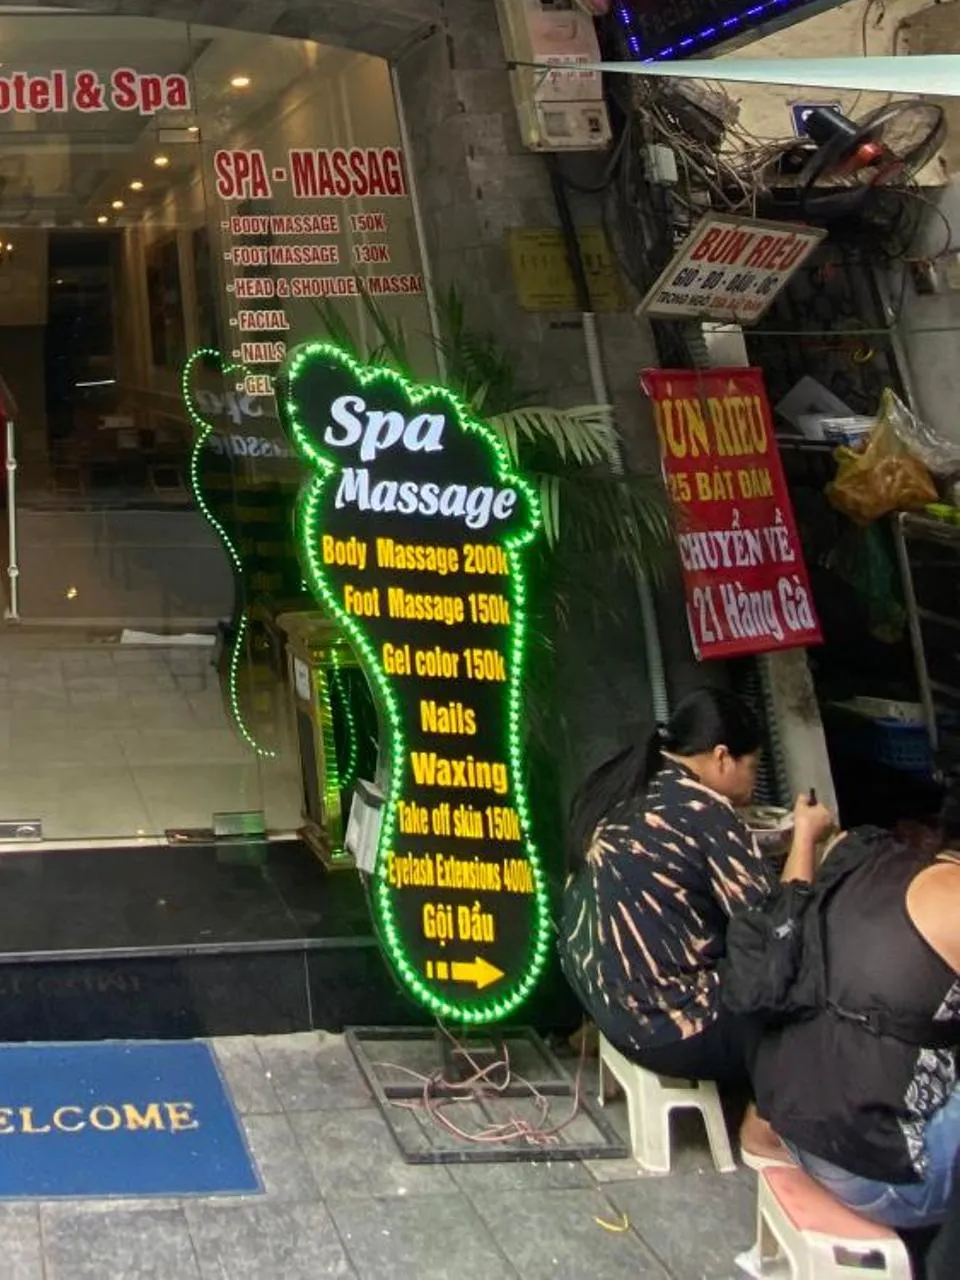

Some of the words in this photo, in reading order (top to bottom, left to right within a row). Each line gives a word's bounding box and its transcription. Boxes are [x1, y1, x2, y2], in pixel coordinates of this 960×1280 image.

[74, 70, 105, 113] &
[112, 68, 191, 114] Spa
[215, 149, 272, 199] SPA
[231, 215, 269, 234] BODY
[270, 215, 339, 234] MASSAGE
[351, 212, 387, 232] 150K
[233, 246, 269, 265] FOOT
[271, 245, 339, 265] MASSAGE
[355, 244, 390, 264] 130K
[234, 278, 274, 298] HEAD
[277, 277, 290, 297] &
[239, 310, 289, 331] FACIAL
[242, 341, 285, 363] NAILS
[244, 375, 274, 395] GEL
[324, 395, 446, 461] Spa
[335, 468, 517, 529] Massage
[322, 535, 367, 570] Body
[376, 537, 459, 575] Massage
[463, 544, 509, 576] 200k
[344, 584, 380, 617] Foot
[388, 588, 464, 625] Massage
[468, 593, 510, 625] 150k
[693, 586, 724, 643] 21
[720, 581, 784, 641] Hàng
[777, 575, 816, 630] Gà
[382, 642, 411, 675] Gel
[415, 646, 458, 678] color
[463, 648, 506, 681] 150k
[420, 700, 476, 734] Nails
[410, 751, 508, 794] Waxing
[397, 800, 428, 834] Take
[432, 802, 450, 836] off
[453, 804, 483, 838] skin
[387, 850, 434, 888] Eyelash
[436, 853, 501, 891] Extensions
